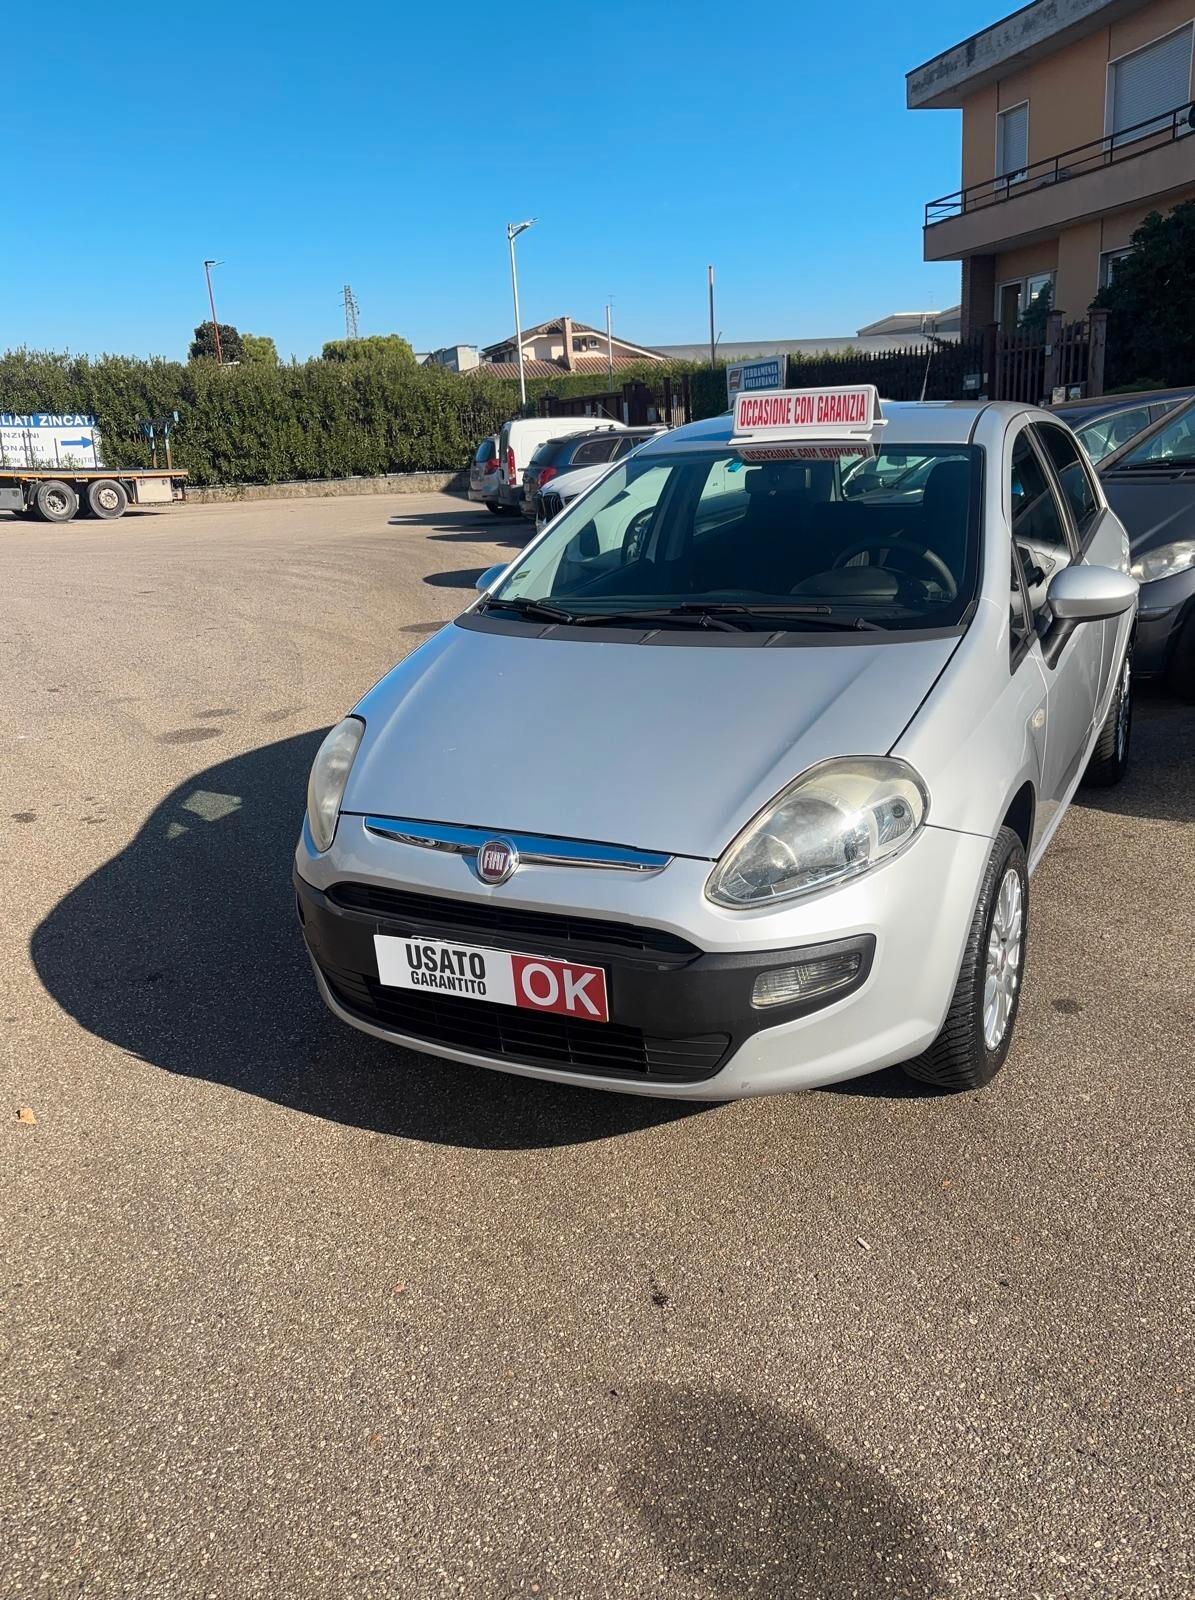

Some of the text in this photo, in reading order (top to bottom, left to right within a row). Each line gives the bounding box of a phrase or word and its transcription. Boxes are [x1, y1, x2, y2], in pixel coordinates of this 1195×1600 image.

[0, 415, 34, 426] LIATI
[740, 393, 865, 427] OCCASIONE CON GARANZIA
[484, 850, 507, 871] FIAT
[405, 943, 486, 980] USATO
[410, 970, 487, 996] GARANTITO
[521, 962, 601, 1016] OK
